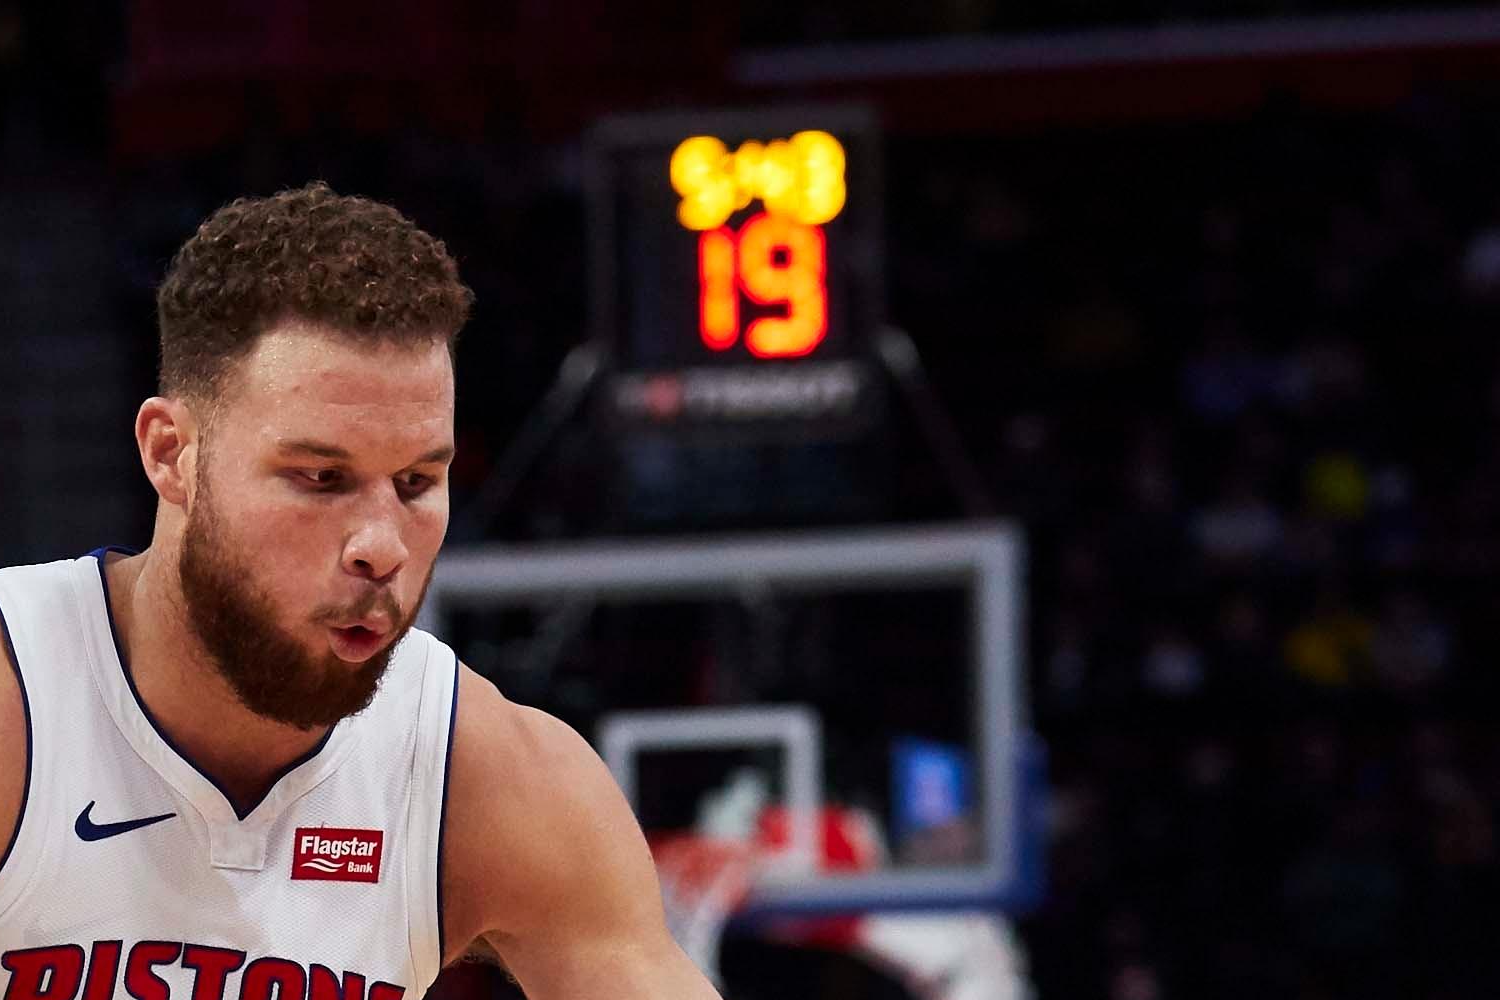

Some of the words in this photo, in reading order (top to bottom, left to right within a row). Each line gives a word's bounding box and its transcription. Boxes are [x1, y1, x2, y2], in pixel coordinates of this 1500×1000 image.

[698, 212, 828, 359] 19
[300, 835, 378, 859] Flagstar
[347, 861, 374, 874] Bank
